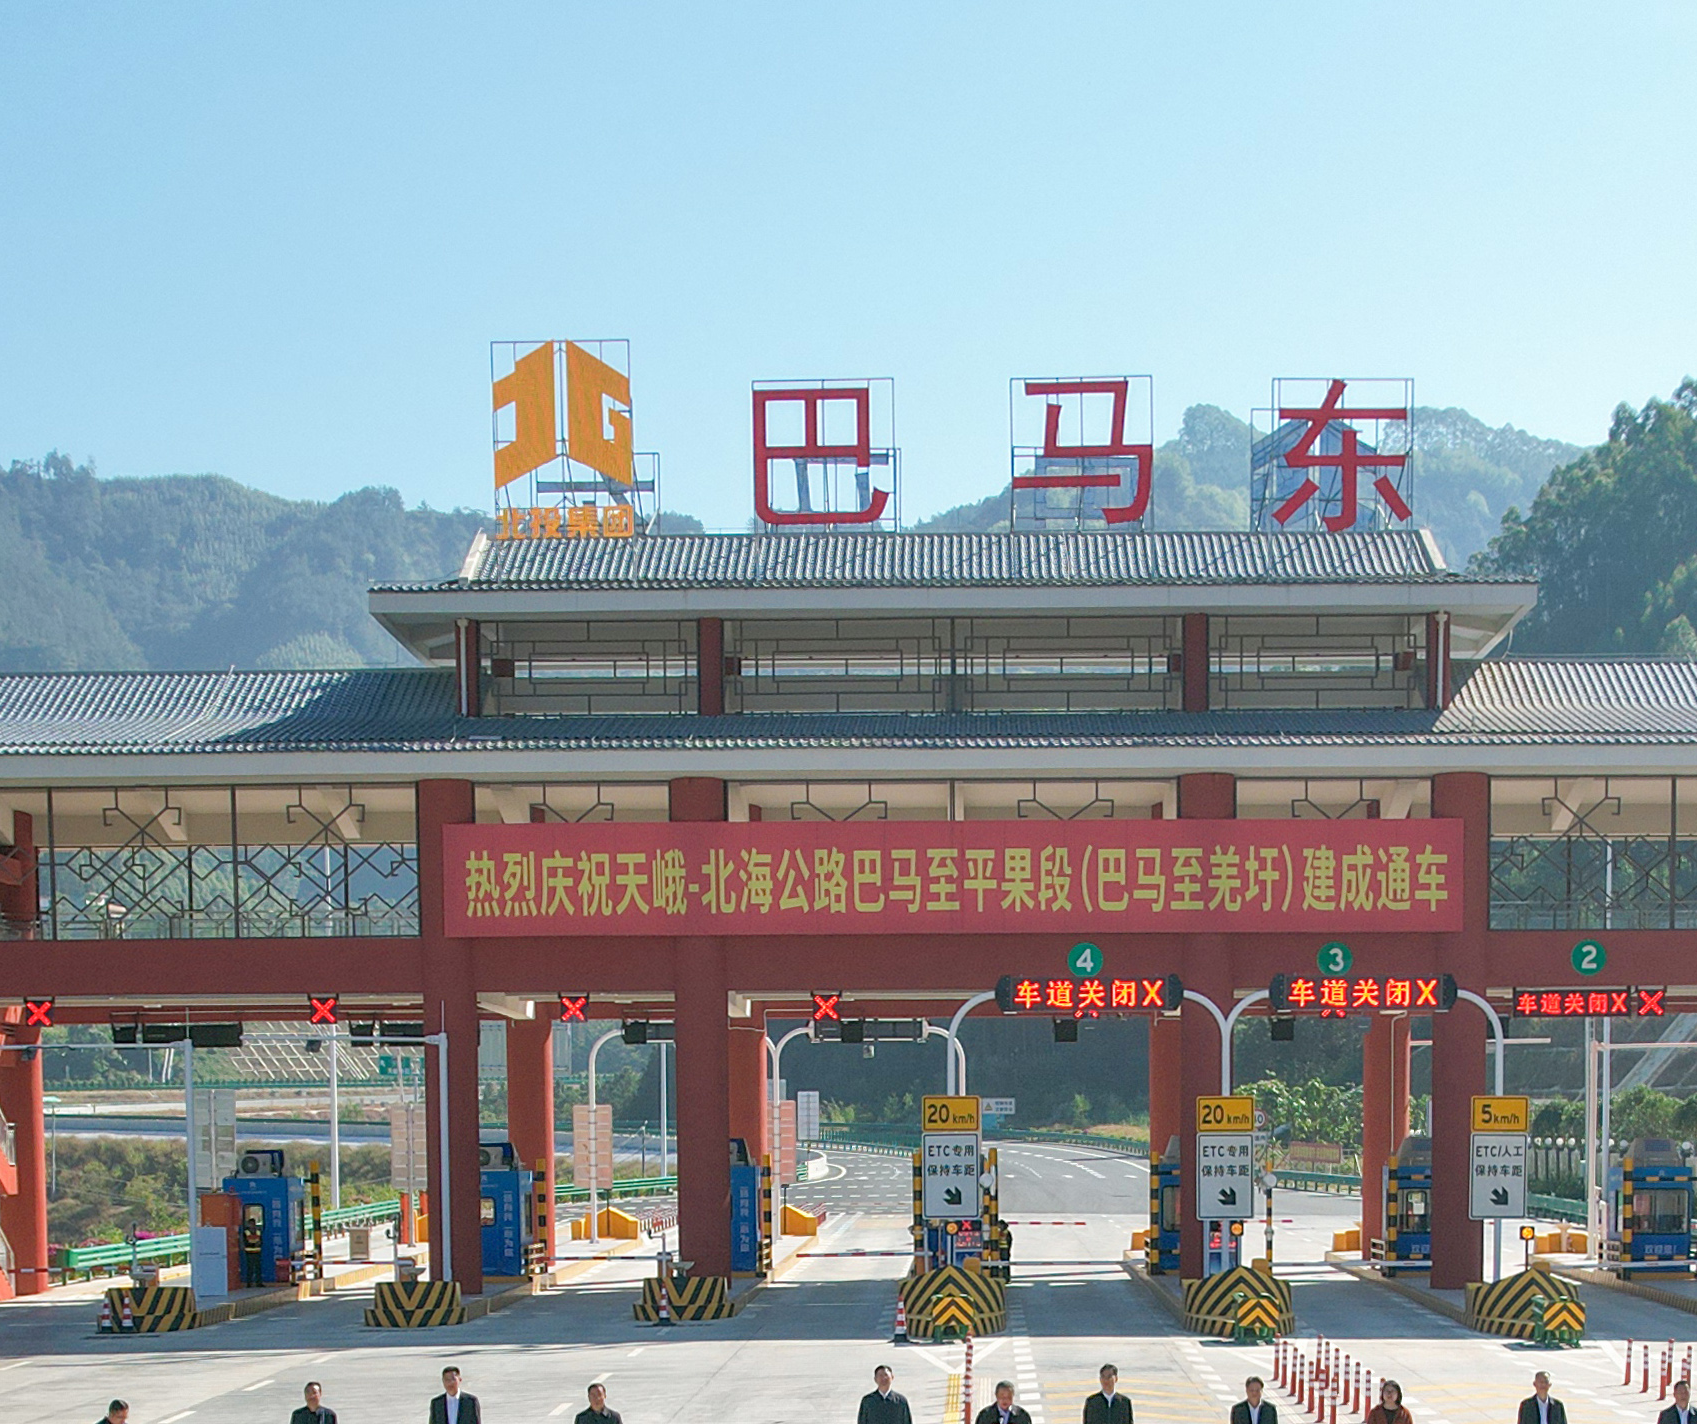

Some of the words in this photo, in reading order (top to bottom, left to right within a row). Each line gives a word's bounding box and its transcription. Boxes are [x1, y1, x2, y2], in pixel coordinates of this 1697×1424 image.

[752, 380, 1412, 532] 巴马东
[496, 505, 633, 540] 北投集团
[1076, 948, 1094, 972] 4
[1329, 947, 1344, 972] 3
[1581, 945, 1597, 969] 2
[927, 1104, 950, 1124] 20
[952, 1112, 975, 1124] km/h
[1202, 1104, 1224, 1124] 20
[1227, 1113, 1250, 1124] km/h
[1475, 1145, 1523, 1157] ETC/人工
[927, 1164, 975, 1176] 保持车距
[1202, 1164, 1250, 1177] 保持车距
[1475, 1164, 1522, 1177] 保持车距
